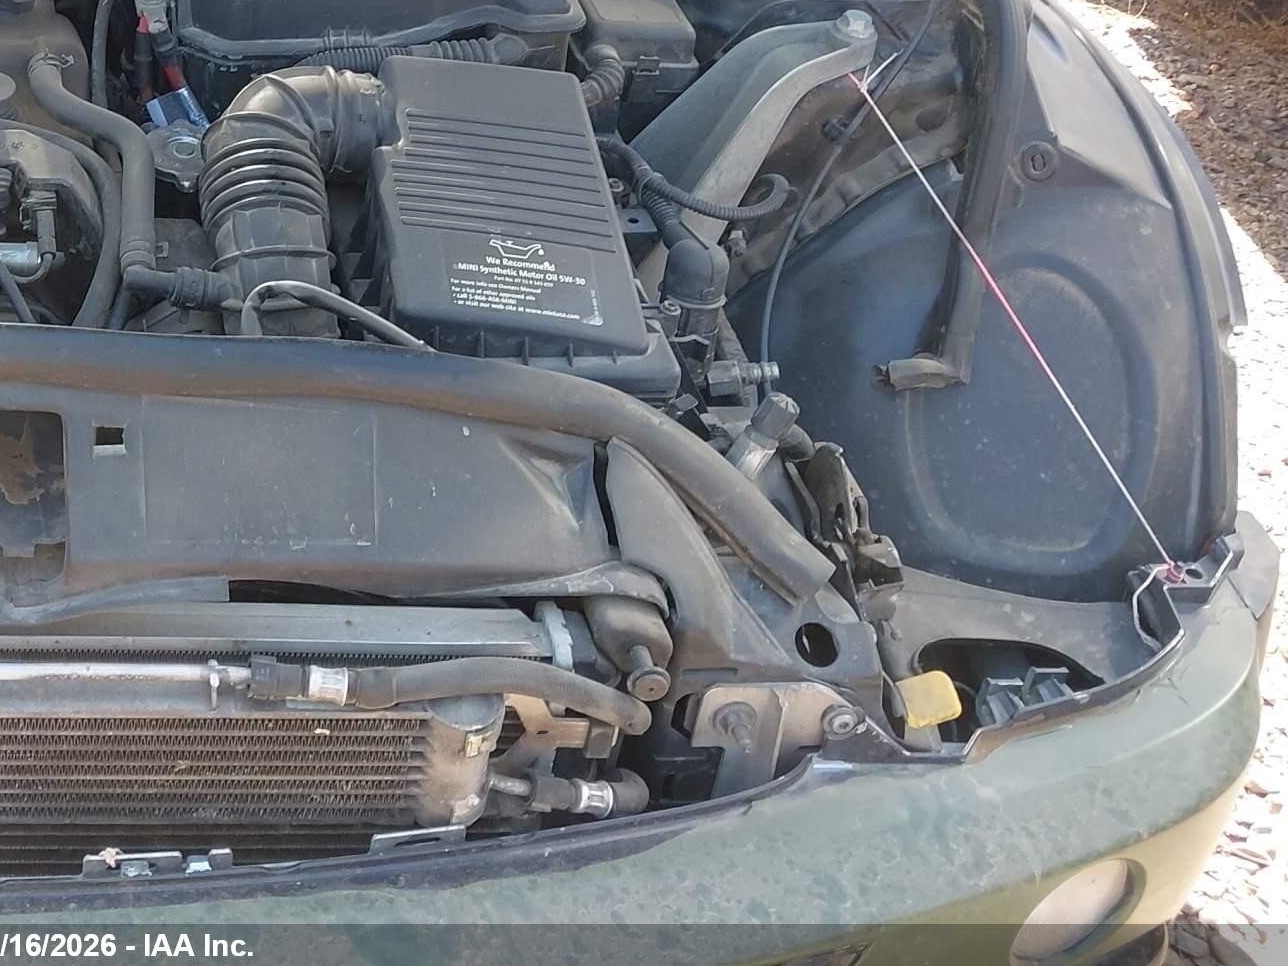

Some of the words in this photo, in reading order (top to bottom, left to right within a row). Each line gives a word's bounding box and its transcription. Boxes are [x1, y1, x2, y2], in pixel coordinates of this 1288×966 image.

[486, 256, 500, 264] We
[502, 258, 555, 271] Recommend
[458, 263, 478, 271] MINI
[480, 265, 517, 276] Synthetic
[519, 270, 544, 279] Motor
[559, 275, 586, 285] 5W-30
